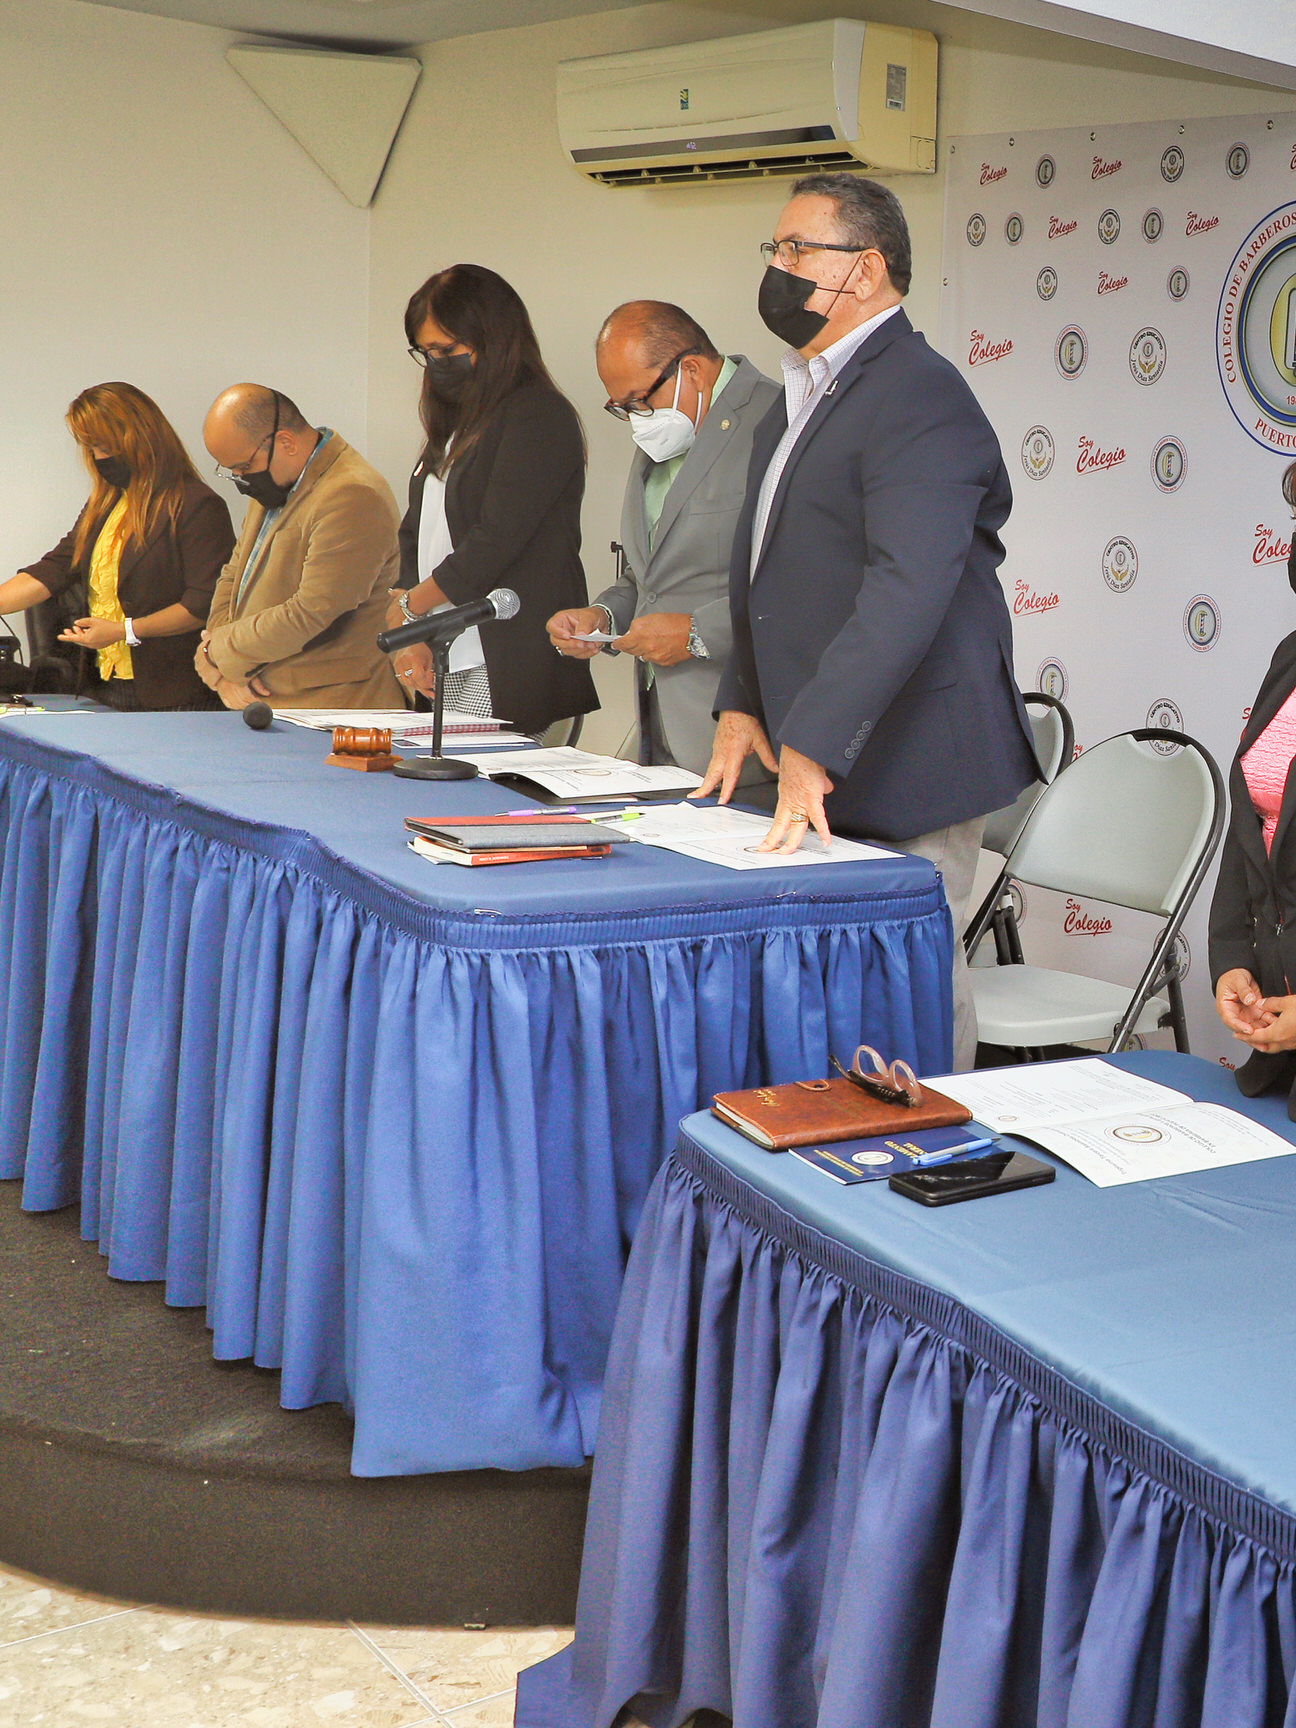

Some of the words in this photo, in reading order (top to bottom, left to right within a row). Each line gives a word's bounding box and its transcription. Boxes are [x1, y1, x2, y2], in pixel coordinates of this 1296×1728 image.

[980, 166, 1007, 185] Colegio
[1091, 160, 1122, 180] Colegio
[1049, 220, 1077, 239] Colegio
[1186, 215, 1219, 236] Colegio
[1097, 276, 1128, 294] Colegio
[1229, 274, 1242, 298] DE
[970, 329, 984, 343] Soy
[1223, 302, 1236, 383] COLEGIO
[969, 338, 1013, 366] Colegio
[1078, 436, 1094, 449] Soy
[1076, 447, 1126, 473] Colegio
[1255, 524, 1273, 539] Soy
[1015, 579, 1029, 592] Soy
[1014, 591, 1059, 613] Colegio
[1074, 744, 1083, 754] oy
[1066, 899, 1081, 911] Soy
[1064, 911, 1113, 936] Colegio
